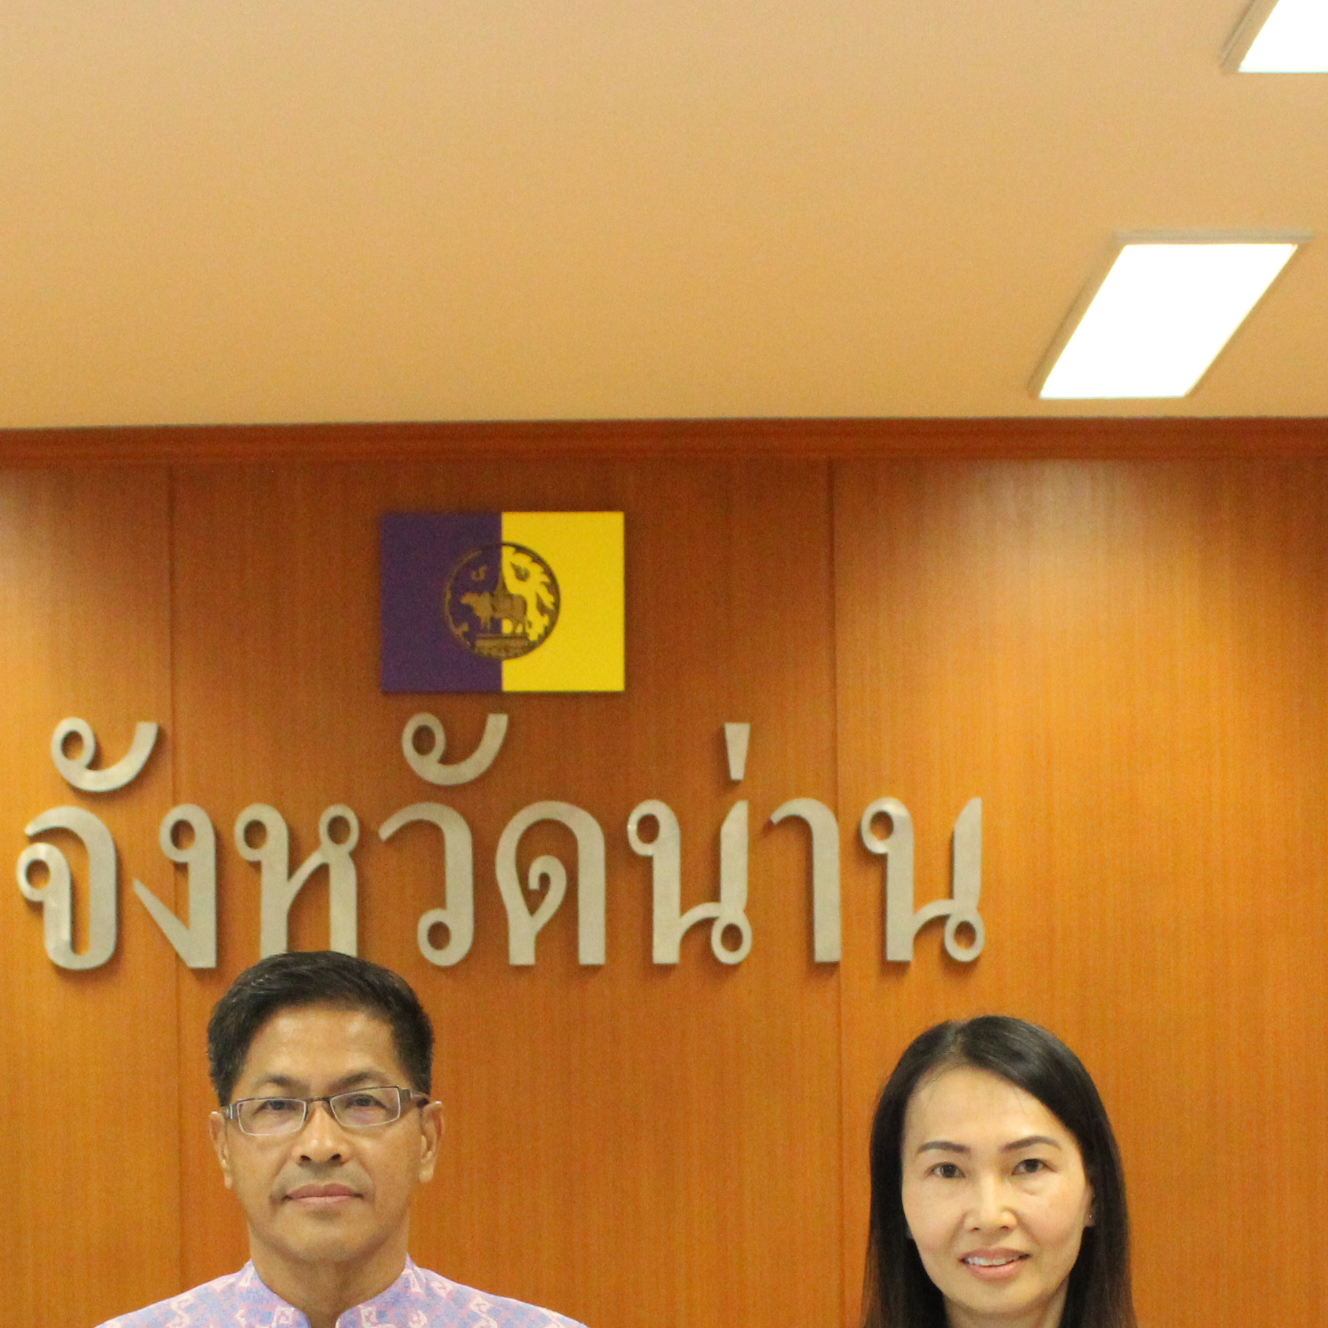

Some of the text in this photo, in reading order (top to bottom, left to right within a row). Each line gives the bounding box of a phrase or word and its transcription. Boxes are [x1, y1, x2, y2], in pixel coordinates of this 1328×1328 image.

[17, 713, 984, 970] จังหวัดน่าน
